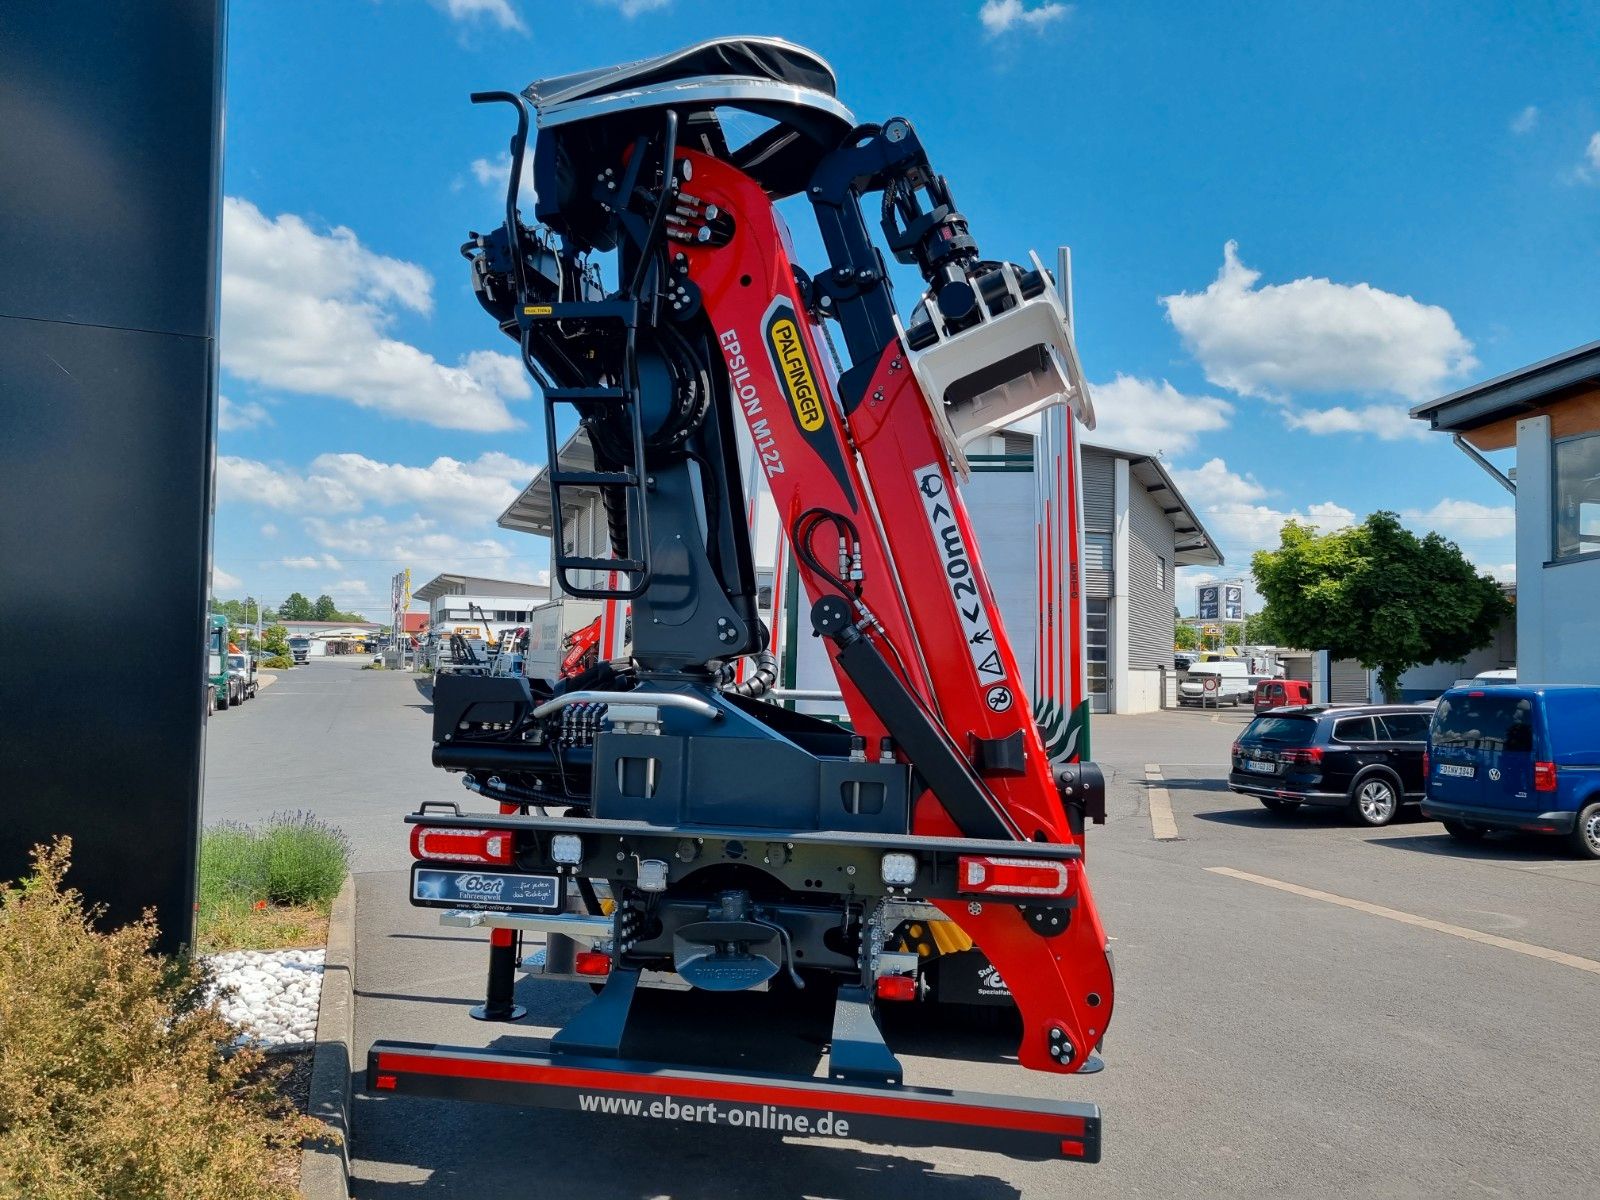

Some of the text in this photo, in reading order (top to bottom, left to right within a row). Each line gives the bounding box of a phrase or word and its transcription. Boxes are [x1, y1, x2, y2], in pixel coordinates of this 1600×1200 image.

[719, 328, 785, 479] EPSILON M12Z
[775, 325, 820, 425] PALFINGER
[940, 524, 977, 601] 20m
[459, 891, 501, 901] Fahrzeugwelt
[465, 876, 502, 892] Ebert
[578, 1094, 850, 1137] www.ebert-online.de
